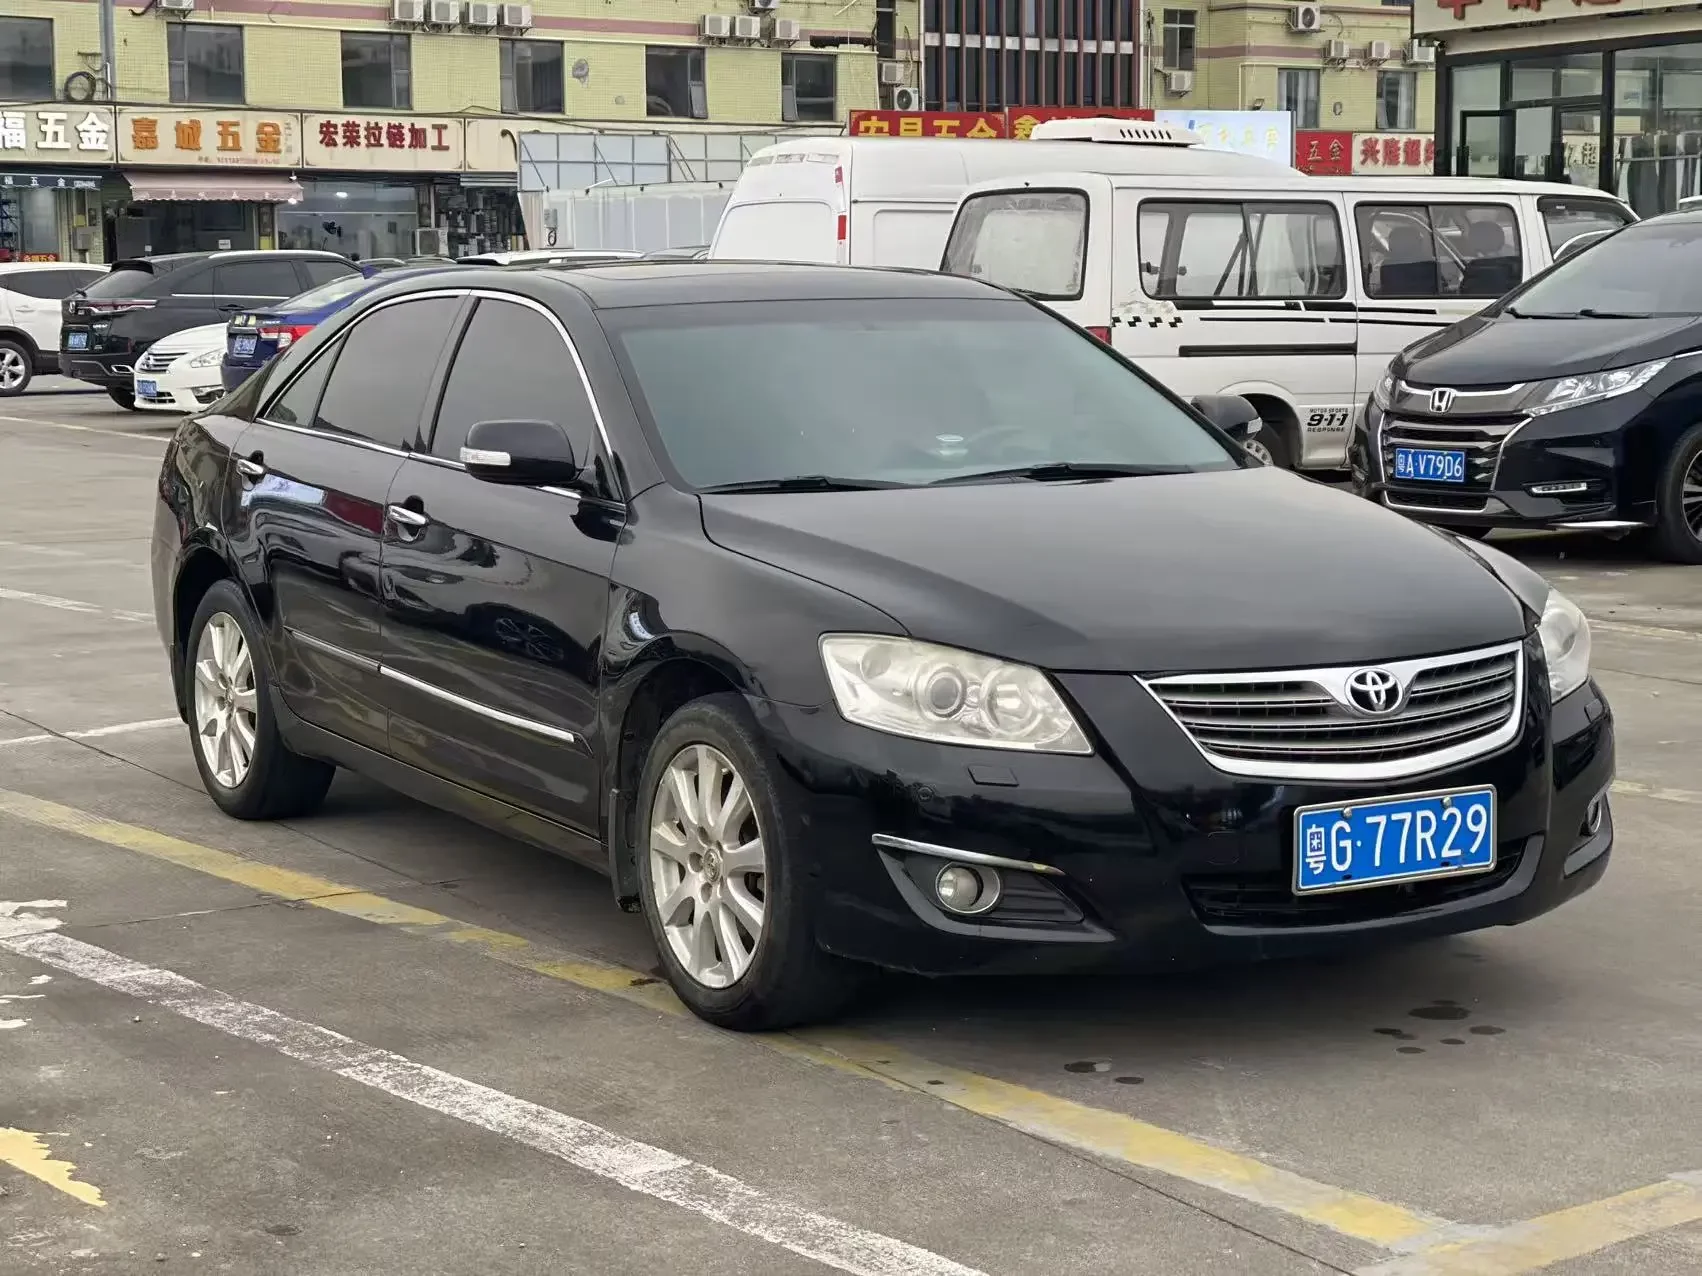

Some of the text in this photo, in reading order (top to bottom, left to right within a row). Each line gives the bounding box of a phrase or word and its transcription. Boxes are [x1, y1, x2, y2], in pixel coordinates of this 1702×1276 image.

[131, 117, 282, 153] 嘉城五金
[319, 120, 450, 151] 宏荣拉链加工
[1296, 139, 1344, 161] 五金
[1305, 803, 1488, 875] 粤G·77R29
